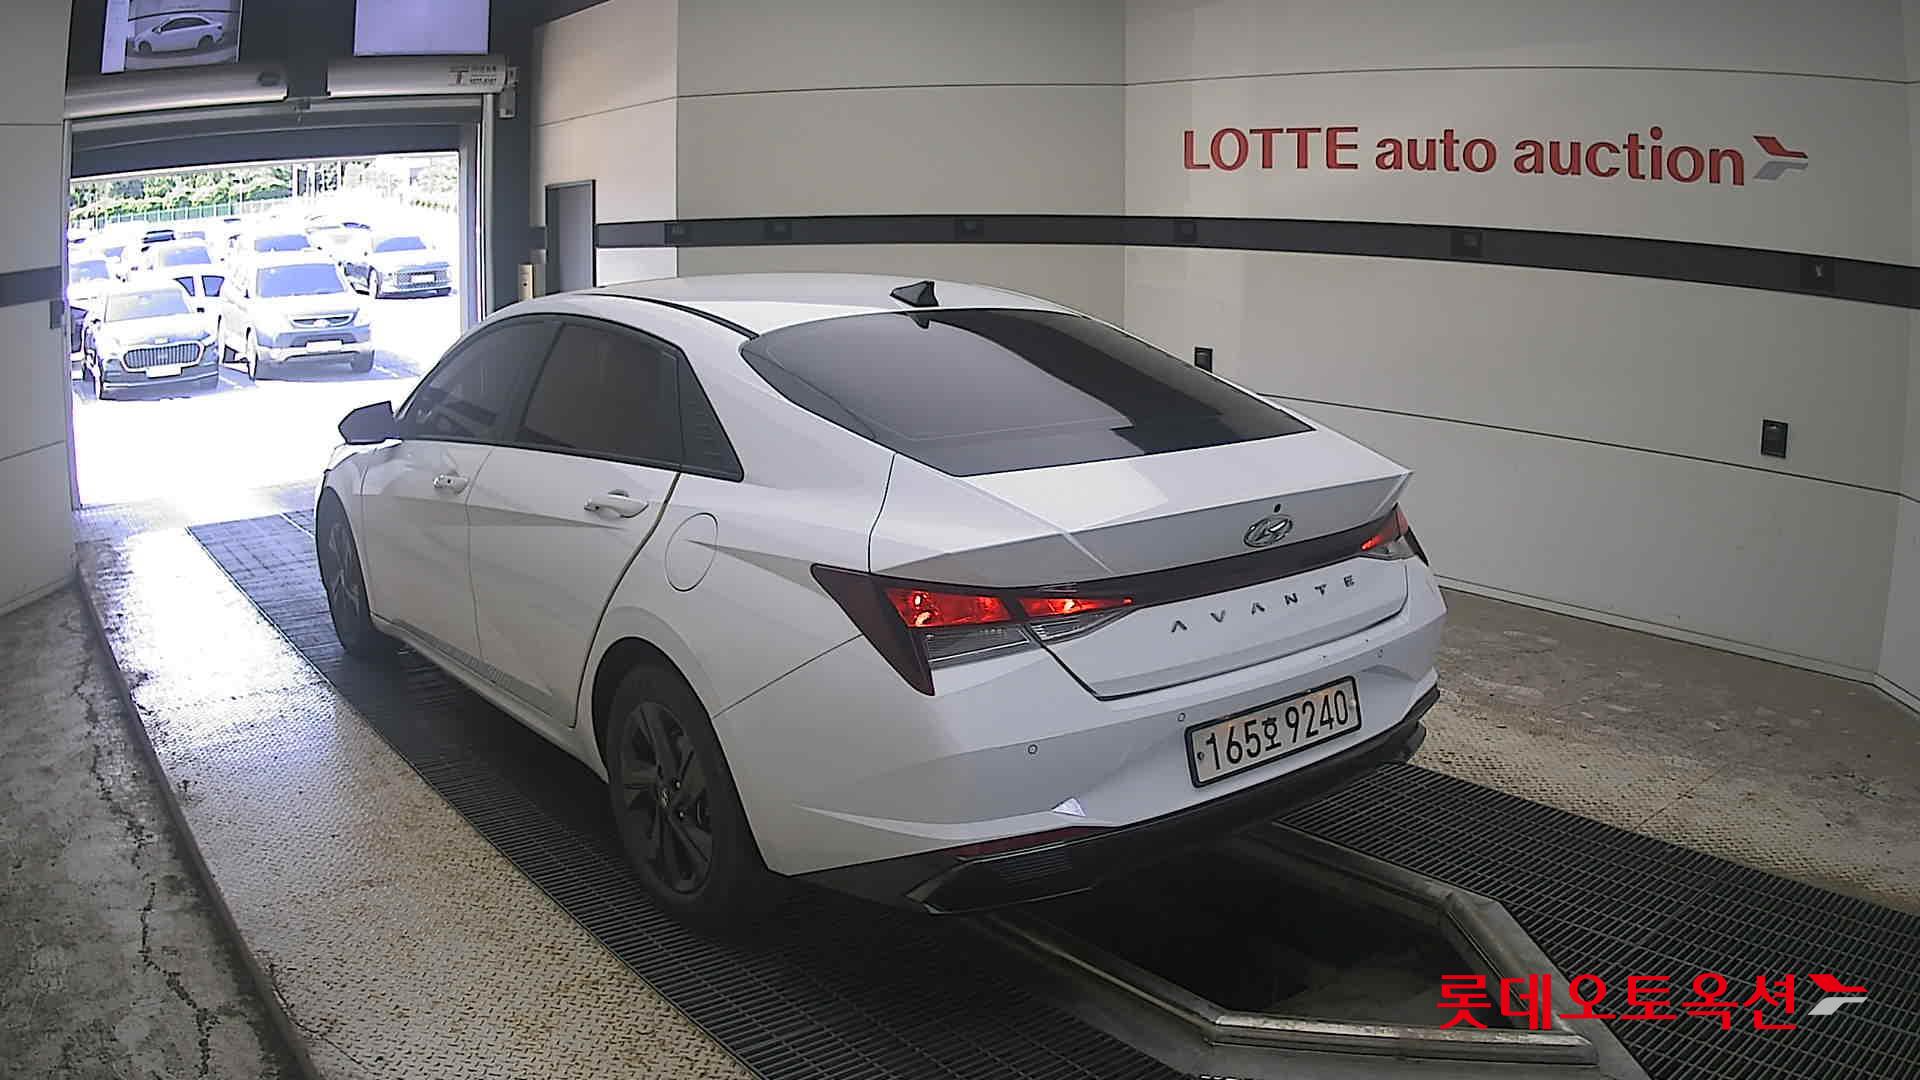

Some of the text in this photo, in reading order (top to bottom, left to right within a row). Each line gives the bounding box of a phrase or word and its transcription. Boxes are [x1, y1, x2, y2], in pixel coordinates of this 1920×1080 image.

[1183, 126, 1745, 186] LOTTE auto auction
[1170, 574, 1356, 634] AVANTE
[1284, 689, 1350, 744] 9240
